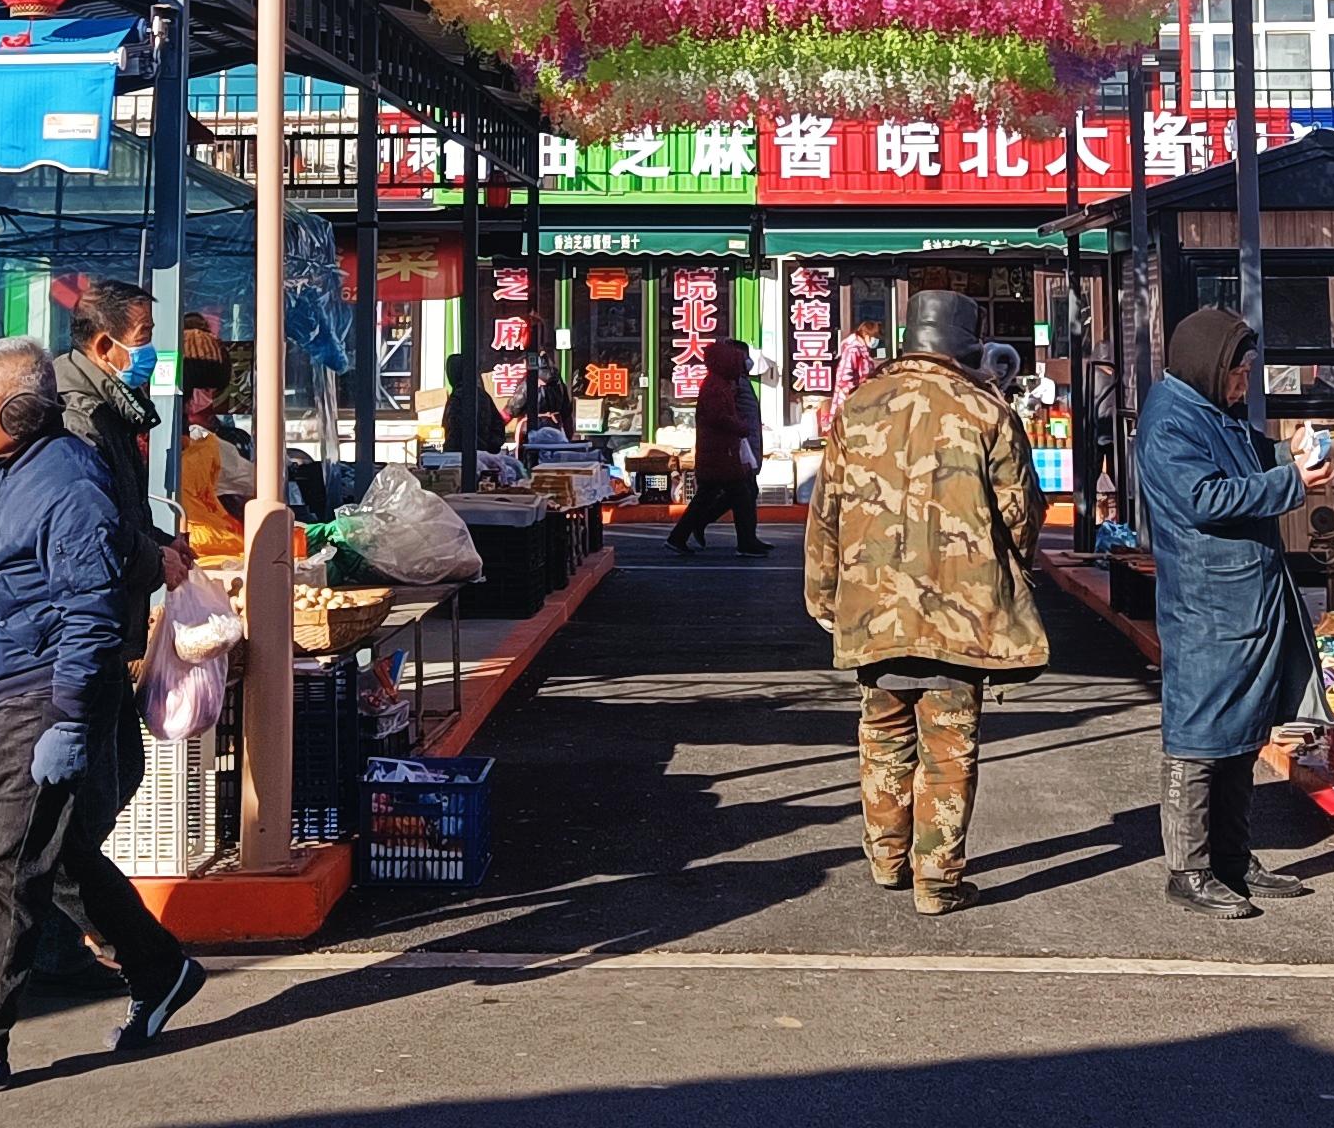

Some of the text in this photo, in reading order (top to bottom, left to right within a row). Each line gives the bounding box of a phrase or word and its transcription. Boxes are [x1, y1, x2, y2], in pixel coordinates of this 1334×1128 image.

[585, 267, 629, 398] 香油
[791, 267, 833, 392] 笨榨豆油
